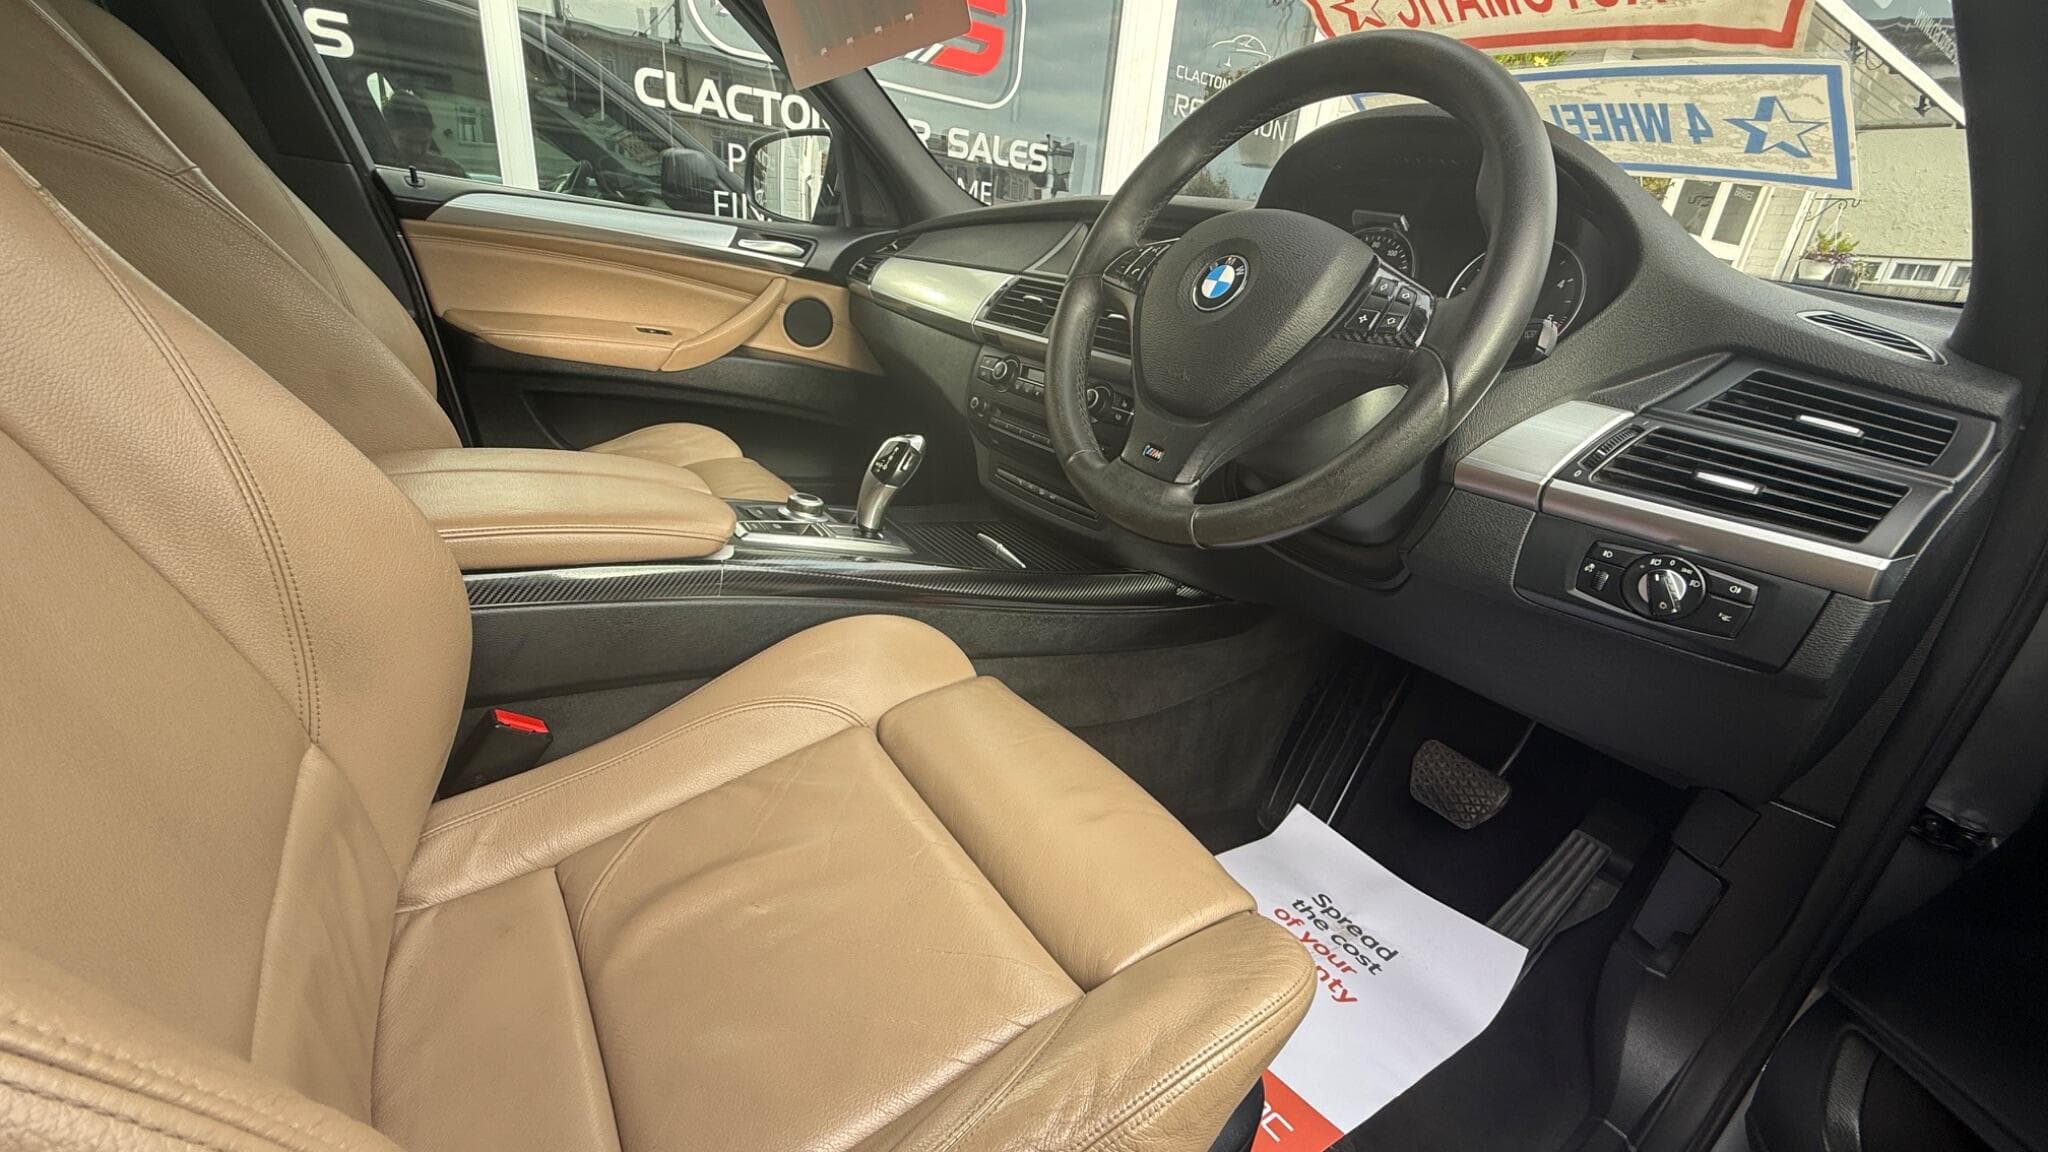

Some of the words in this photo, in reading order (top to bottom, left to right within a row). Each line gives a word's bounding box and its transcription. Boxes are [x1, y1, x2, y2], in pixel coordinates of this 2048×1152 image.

[1176, 64, 1231, 90] CLACTON
[947, 126, 1049, 173] SALES
[1273, 907, 1306, 928] of
[1300, 931, 1359, 975] your
[1292, 898, 1329, 932] the
[1330, 933, 1383, 976] cost
[1311, 893, 1399, 962] Spread
